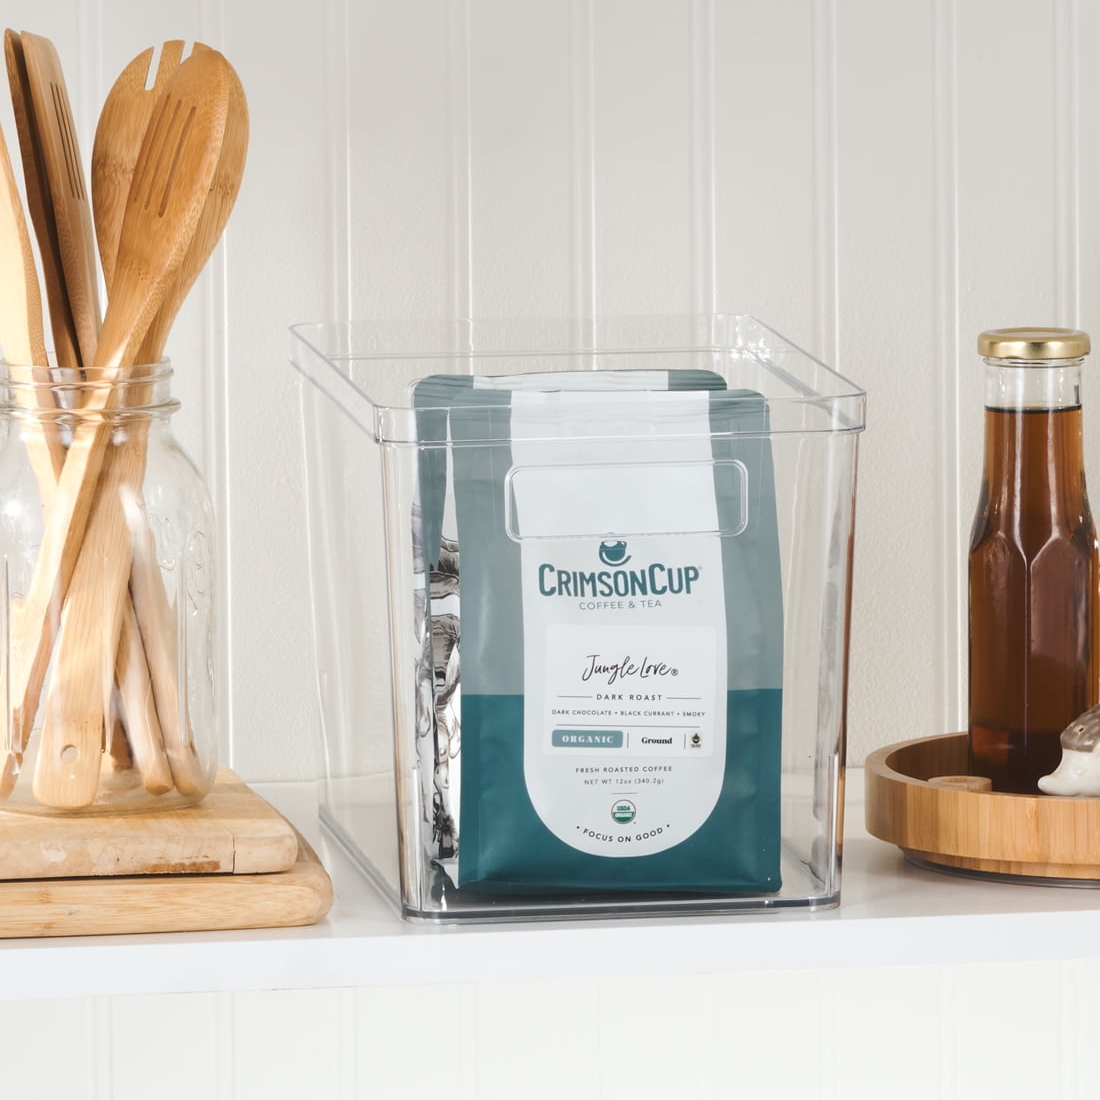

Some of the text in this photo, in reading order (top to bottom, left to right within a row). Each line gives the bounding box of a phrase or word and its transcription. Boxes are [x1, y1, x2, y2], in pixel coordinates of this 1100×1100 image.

[579, 599, 663, 611] COFFEE & TEA
[581, 654, 639, 685] Jungle
[596, 693, 624, 701] DARK
[562, 734, 673, 745] ORGANIC Ground
[583, 828, 613, 842] FOCUS
[635, 827, 663, 841] GOOD
